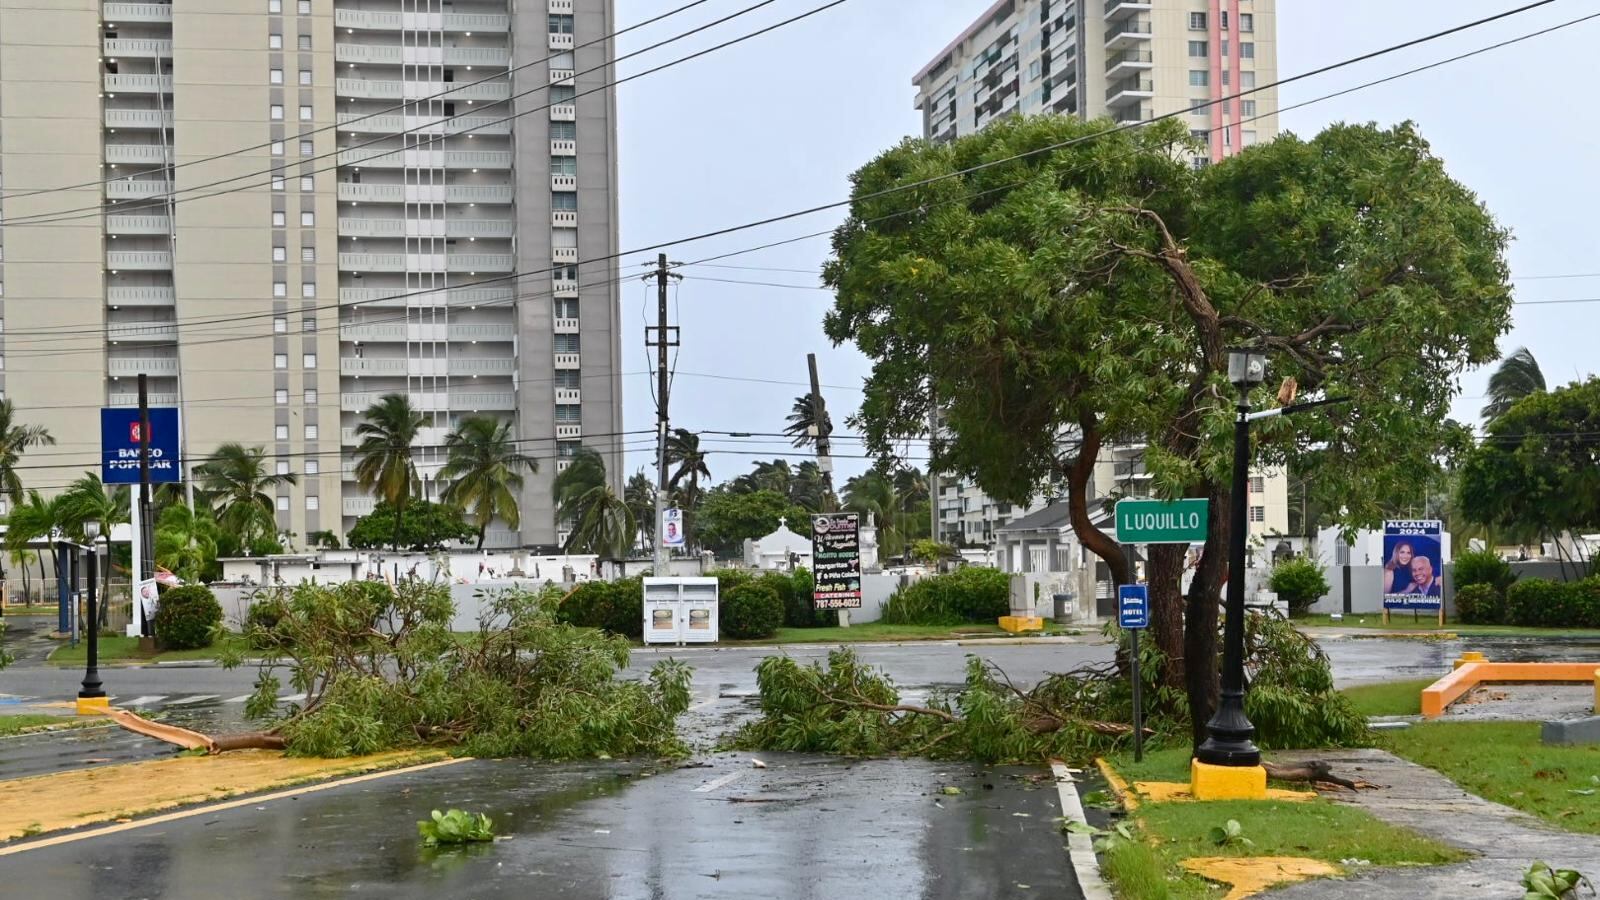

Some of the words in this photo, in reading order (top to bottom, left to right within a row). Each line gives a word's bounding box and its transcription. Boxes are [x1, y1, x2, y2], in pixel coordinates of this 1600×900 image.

[1125, 512, 1199, 530] LUQUILLO
[815, 562, 848, 570] Margaritas
[816, 583, 832, 591] Fresh
[834, 582, 846, 591] Fish
